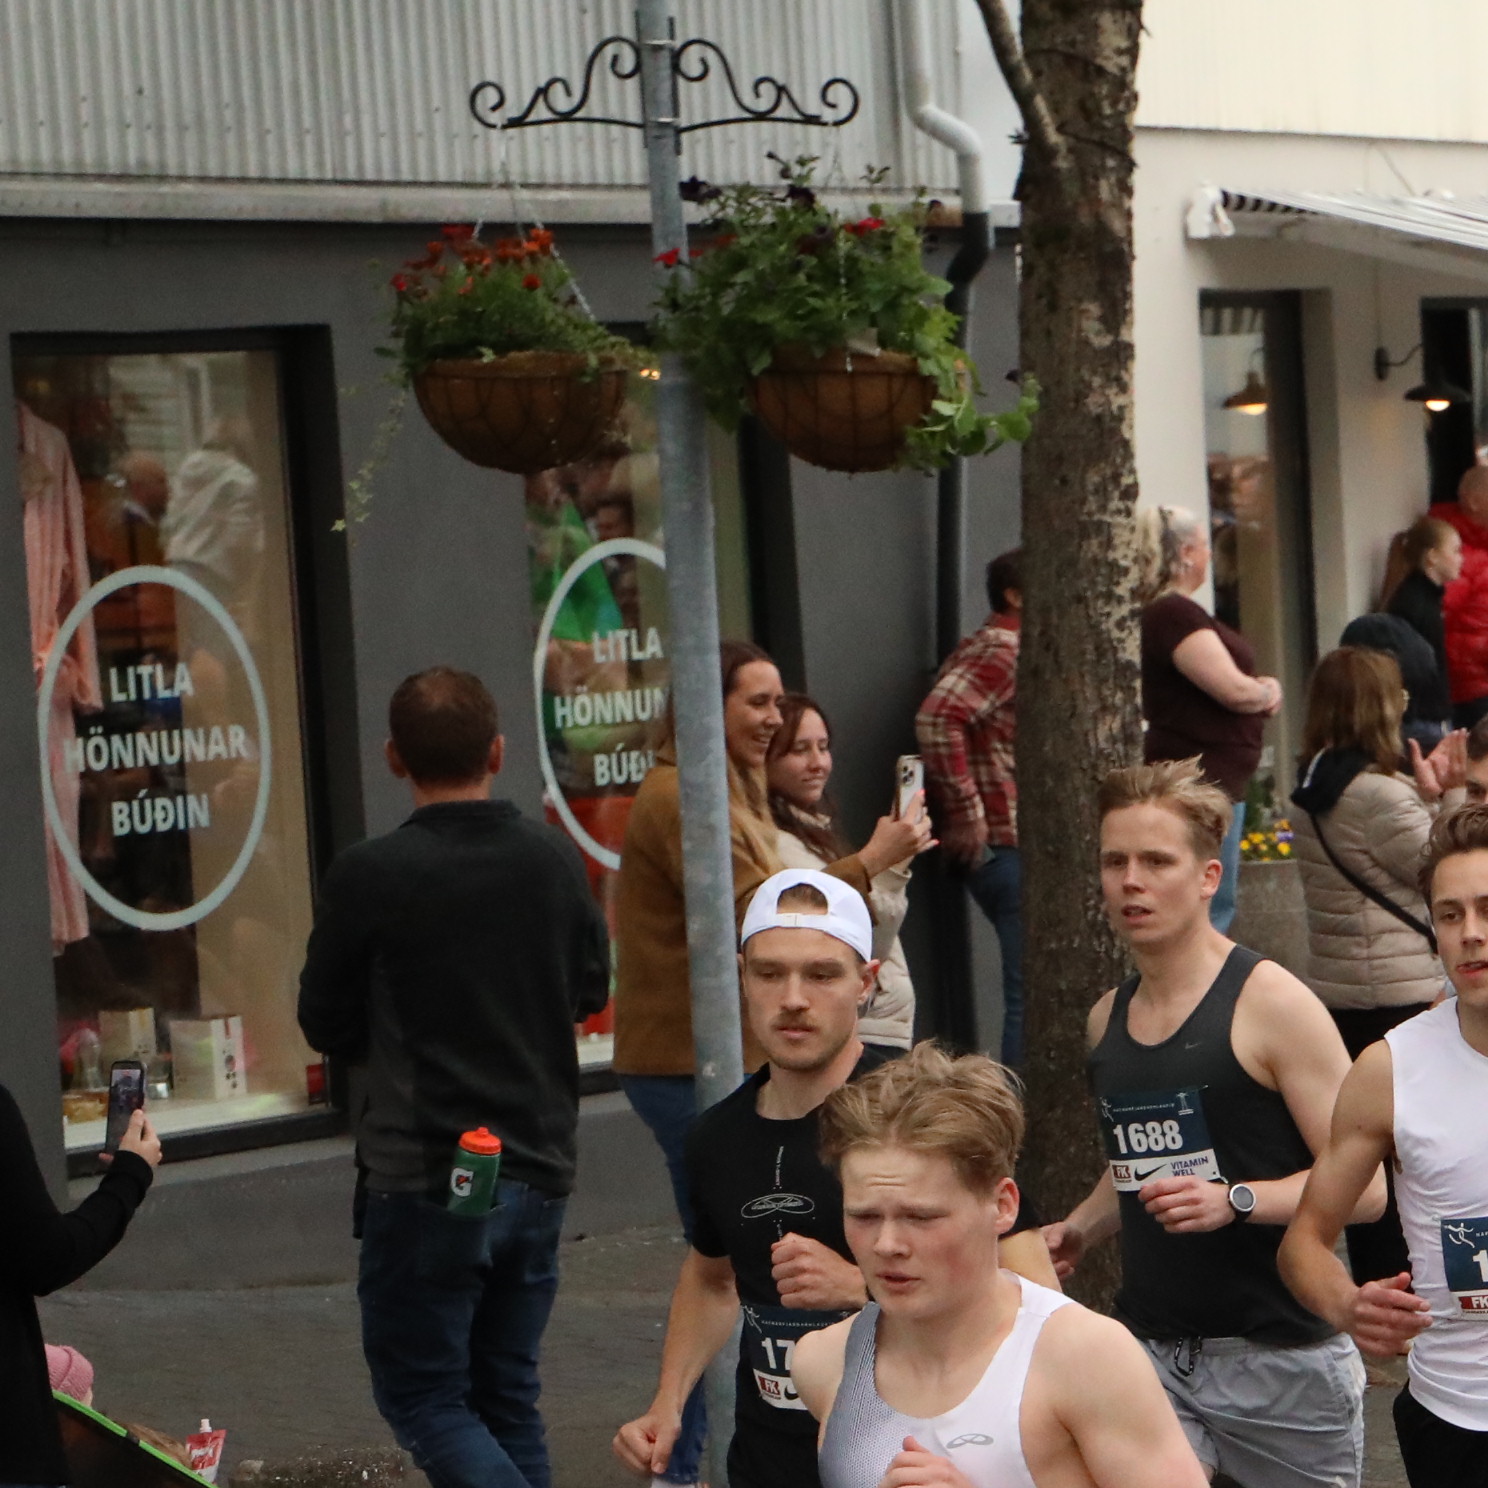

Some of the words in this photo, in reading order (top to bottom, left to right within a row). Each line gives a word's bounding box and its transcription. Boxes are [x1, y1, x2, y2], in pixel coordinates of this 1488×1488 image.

[592, 627, 665, 664] LITLA
[109, 662, 194, 702] LITLA
[63, 725, 250, 773] HÖNNUNAR
[111, 789, 210, 837] BÚÐIN
[1113, 1120, 1184, 1154] 1688
[1171, 1156, 1209, 1170] VITAMIN
